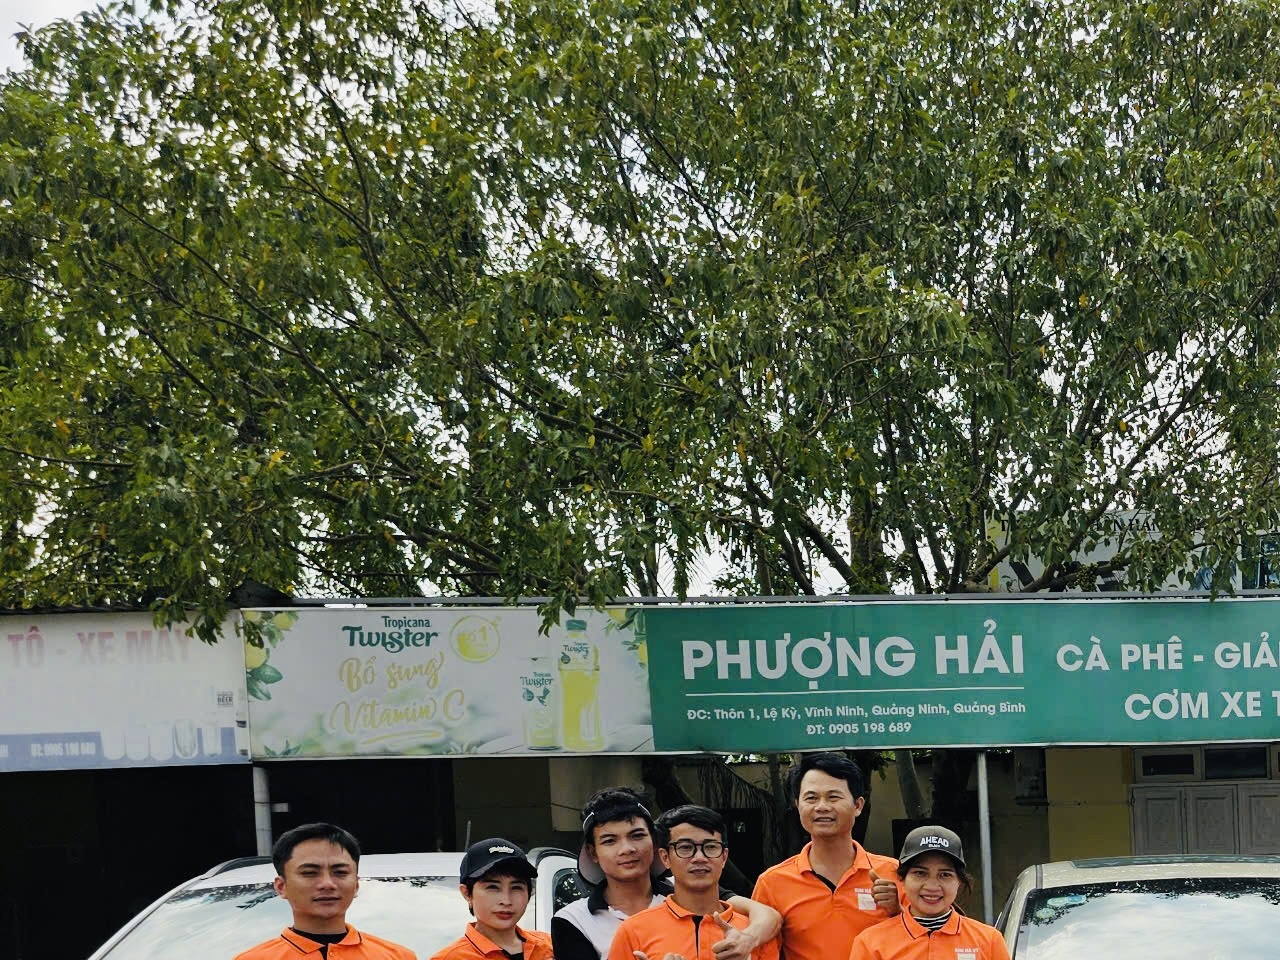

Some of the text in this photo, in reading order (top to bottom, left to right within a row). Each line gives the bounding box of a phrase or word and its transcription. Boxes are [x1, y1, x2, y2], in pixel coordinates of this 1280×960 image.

[381, 616, 431, 629] Tropicana
[342, 625, 439, 653] Twister
[1056, 635, 1110, 672] CÀ
[1121, 635, 1183, 670] PHÊ
[682, 619, 1024, 690] PHƯỢNG HẢI
[386, 651, 445, 689] sung
[329, 689, 465, 735] Vitamin C
[687, 709, 711, 720] ĐC:
[714, 708, 744, 720] Thôn
[749, 708, 760, 720] 1,
[764, 708, 778, 721] Lệ
[782, 706, 801, 720] Kỳ,
[836, 705, 868, 718] Ninh,
[872, 703, 915, 718] Quảng
[918, 704, 950, 716] Ninh,
[953, 701, 996, 716] Quảng
[1000, 701, 1025, 713] Bình
[1124, 690, 1209, 721] CƠM
[1220, 691, 1261, 718] XE
[807, 722, 912, 735] ĐT: 0905 198 689
[920, 835, 949, 848] AHEAD
